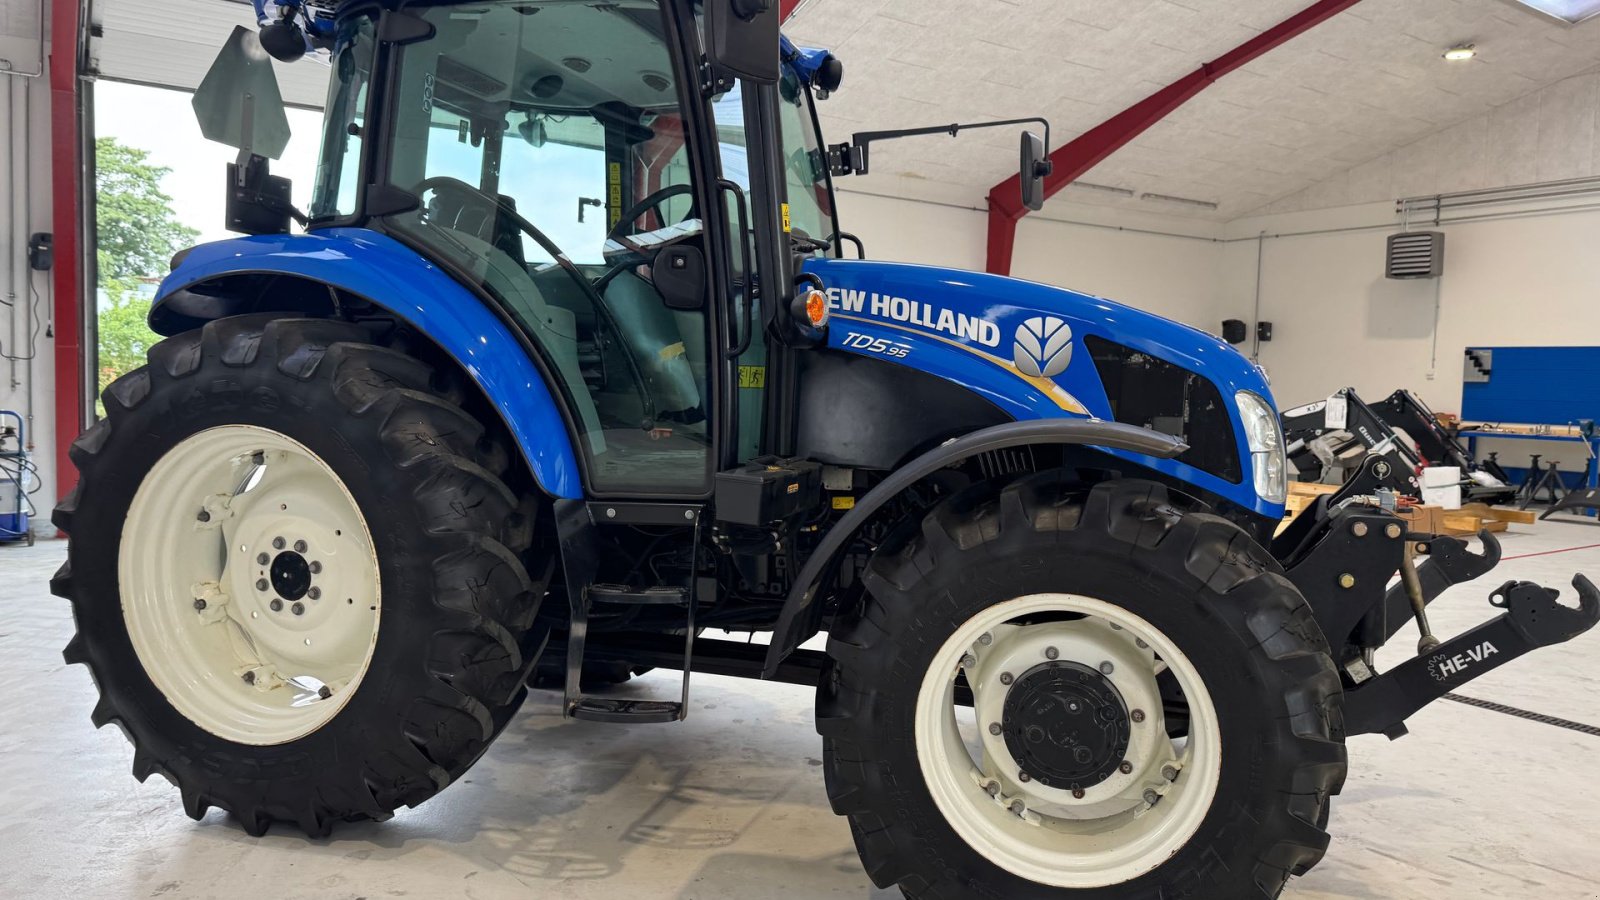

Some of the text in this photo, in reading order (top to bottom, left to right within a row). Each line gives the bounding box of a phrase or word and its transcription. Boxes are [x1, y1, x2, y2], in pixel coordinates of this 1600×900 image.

[807, 286, 1001, 348] EW HOLLAND
[842, 332, 911, 358] TD5.95
[1439, 641, 1499, 678] HE-VA
